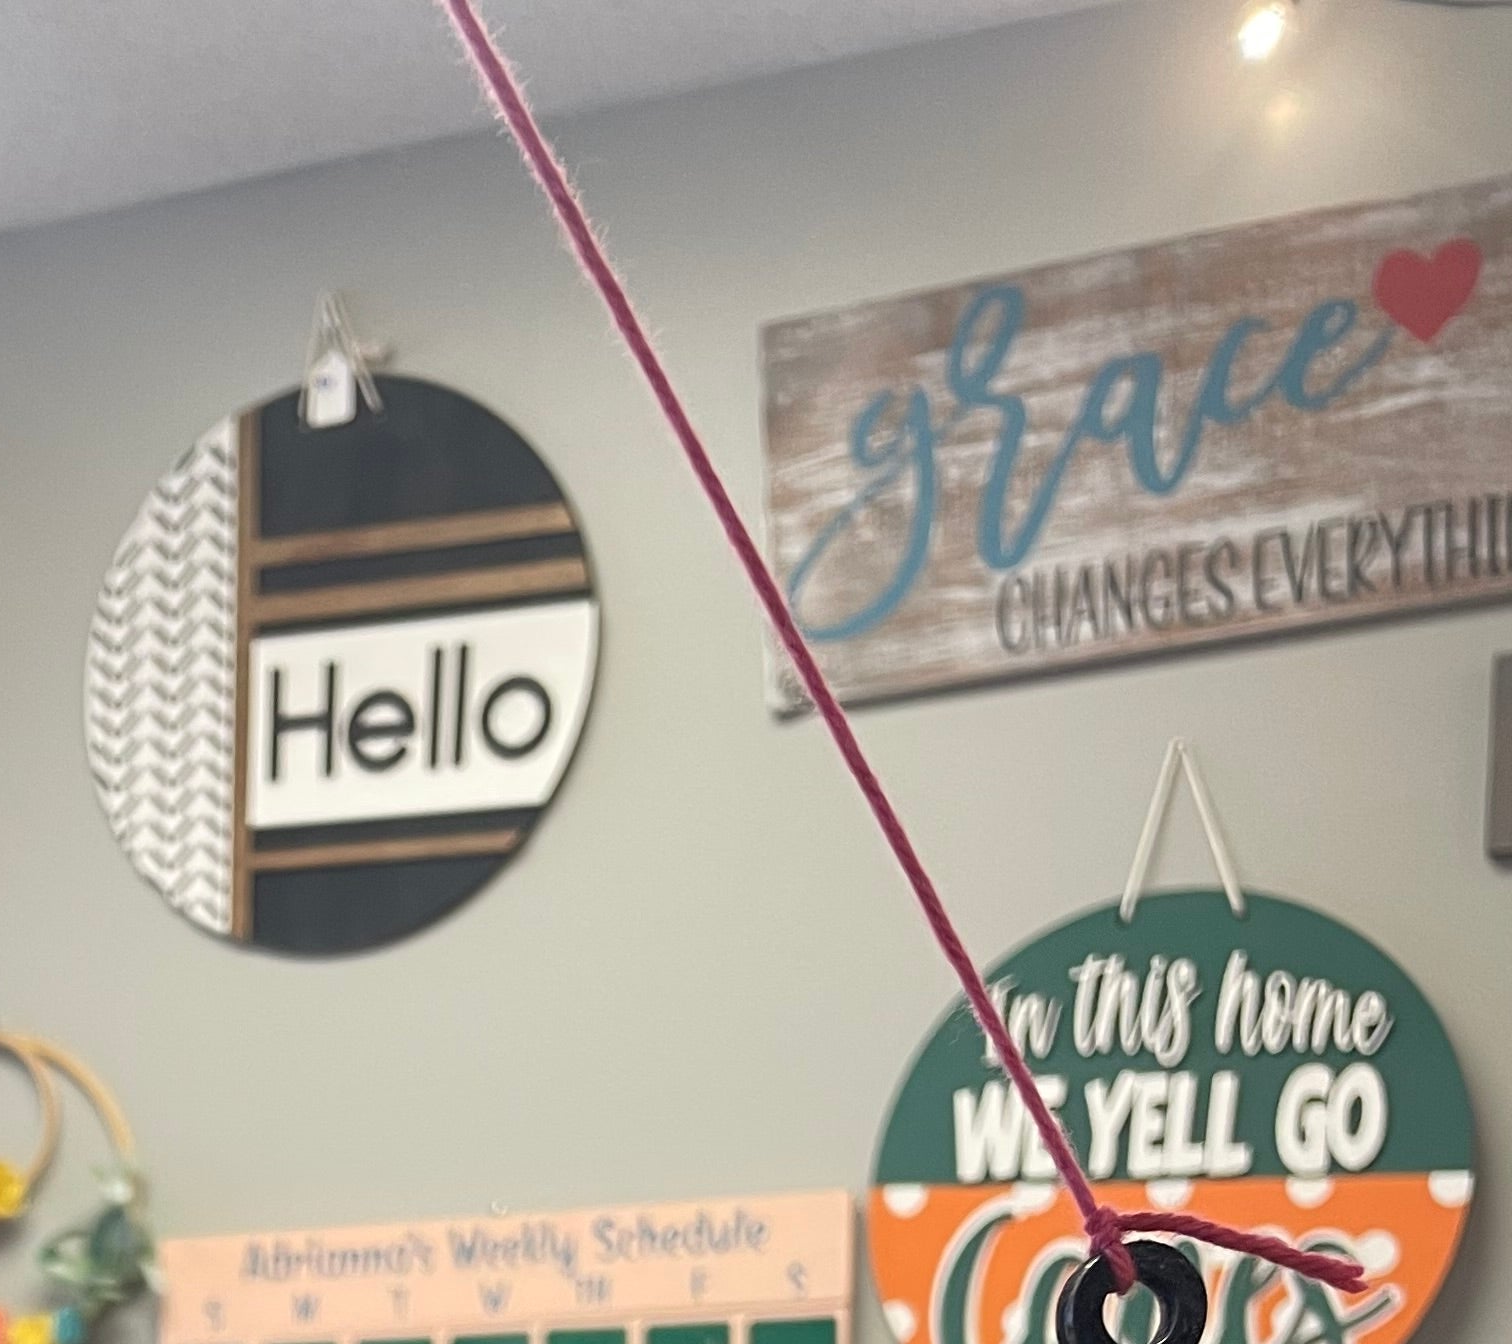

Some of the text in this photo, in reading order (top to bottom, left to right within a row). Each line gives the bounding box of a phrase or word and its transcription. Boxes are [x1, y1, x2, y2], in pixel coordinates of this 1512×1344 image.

[788, 285, 1396, 642] grace
[995, 535, 1238, 655] CHANGES
[267, 641, 552, 782] Hello
[1068, 952, 1203, 1068] this
[1214, 948, 1395, 1057] home
[953, 1061, 1388, 1183] WE YELL GO
[446, 1221, 578, 1278] Weekly
[591, 1207, 771, 1263] Schedule
